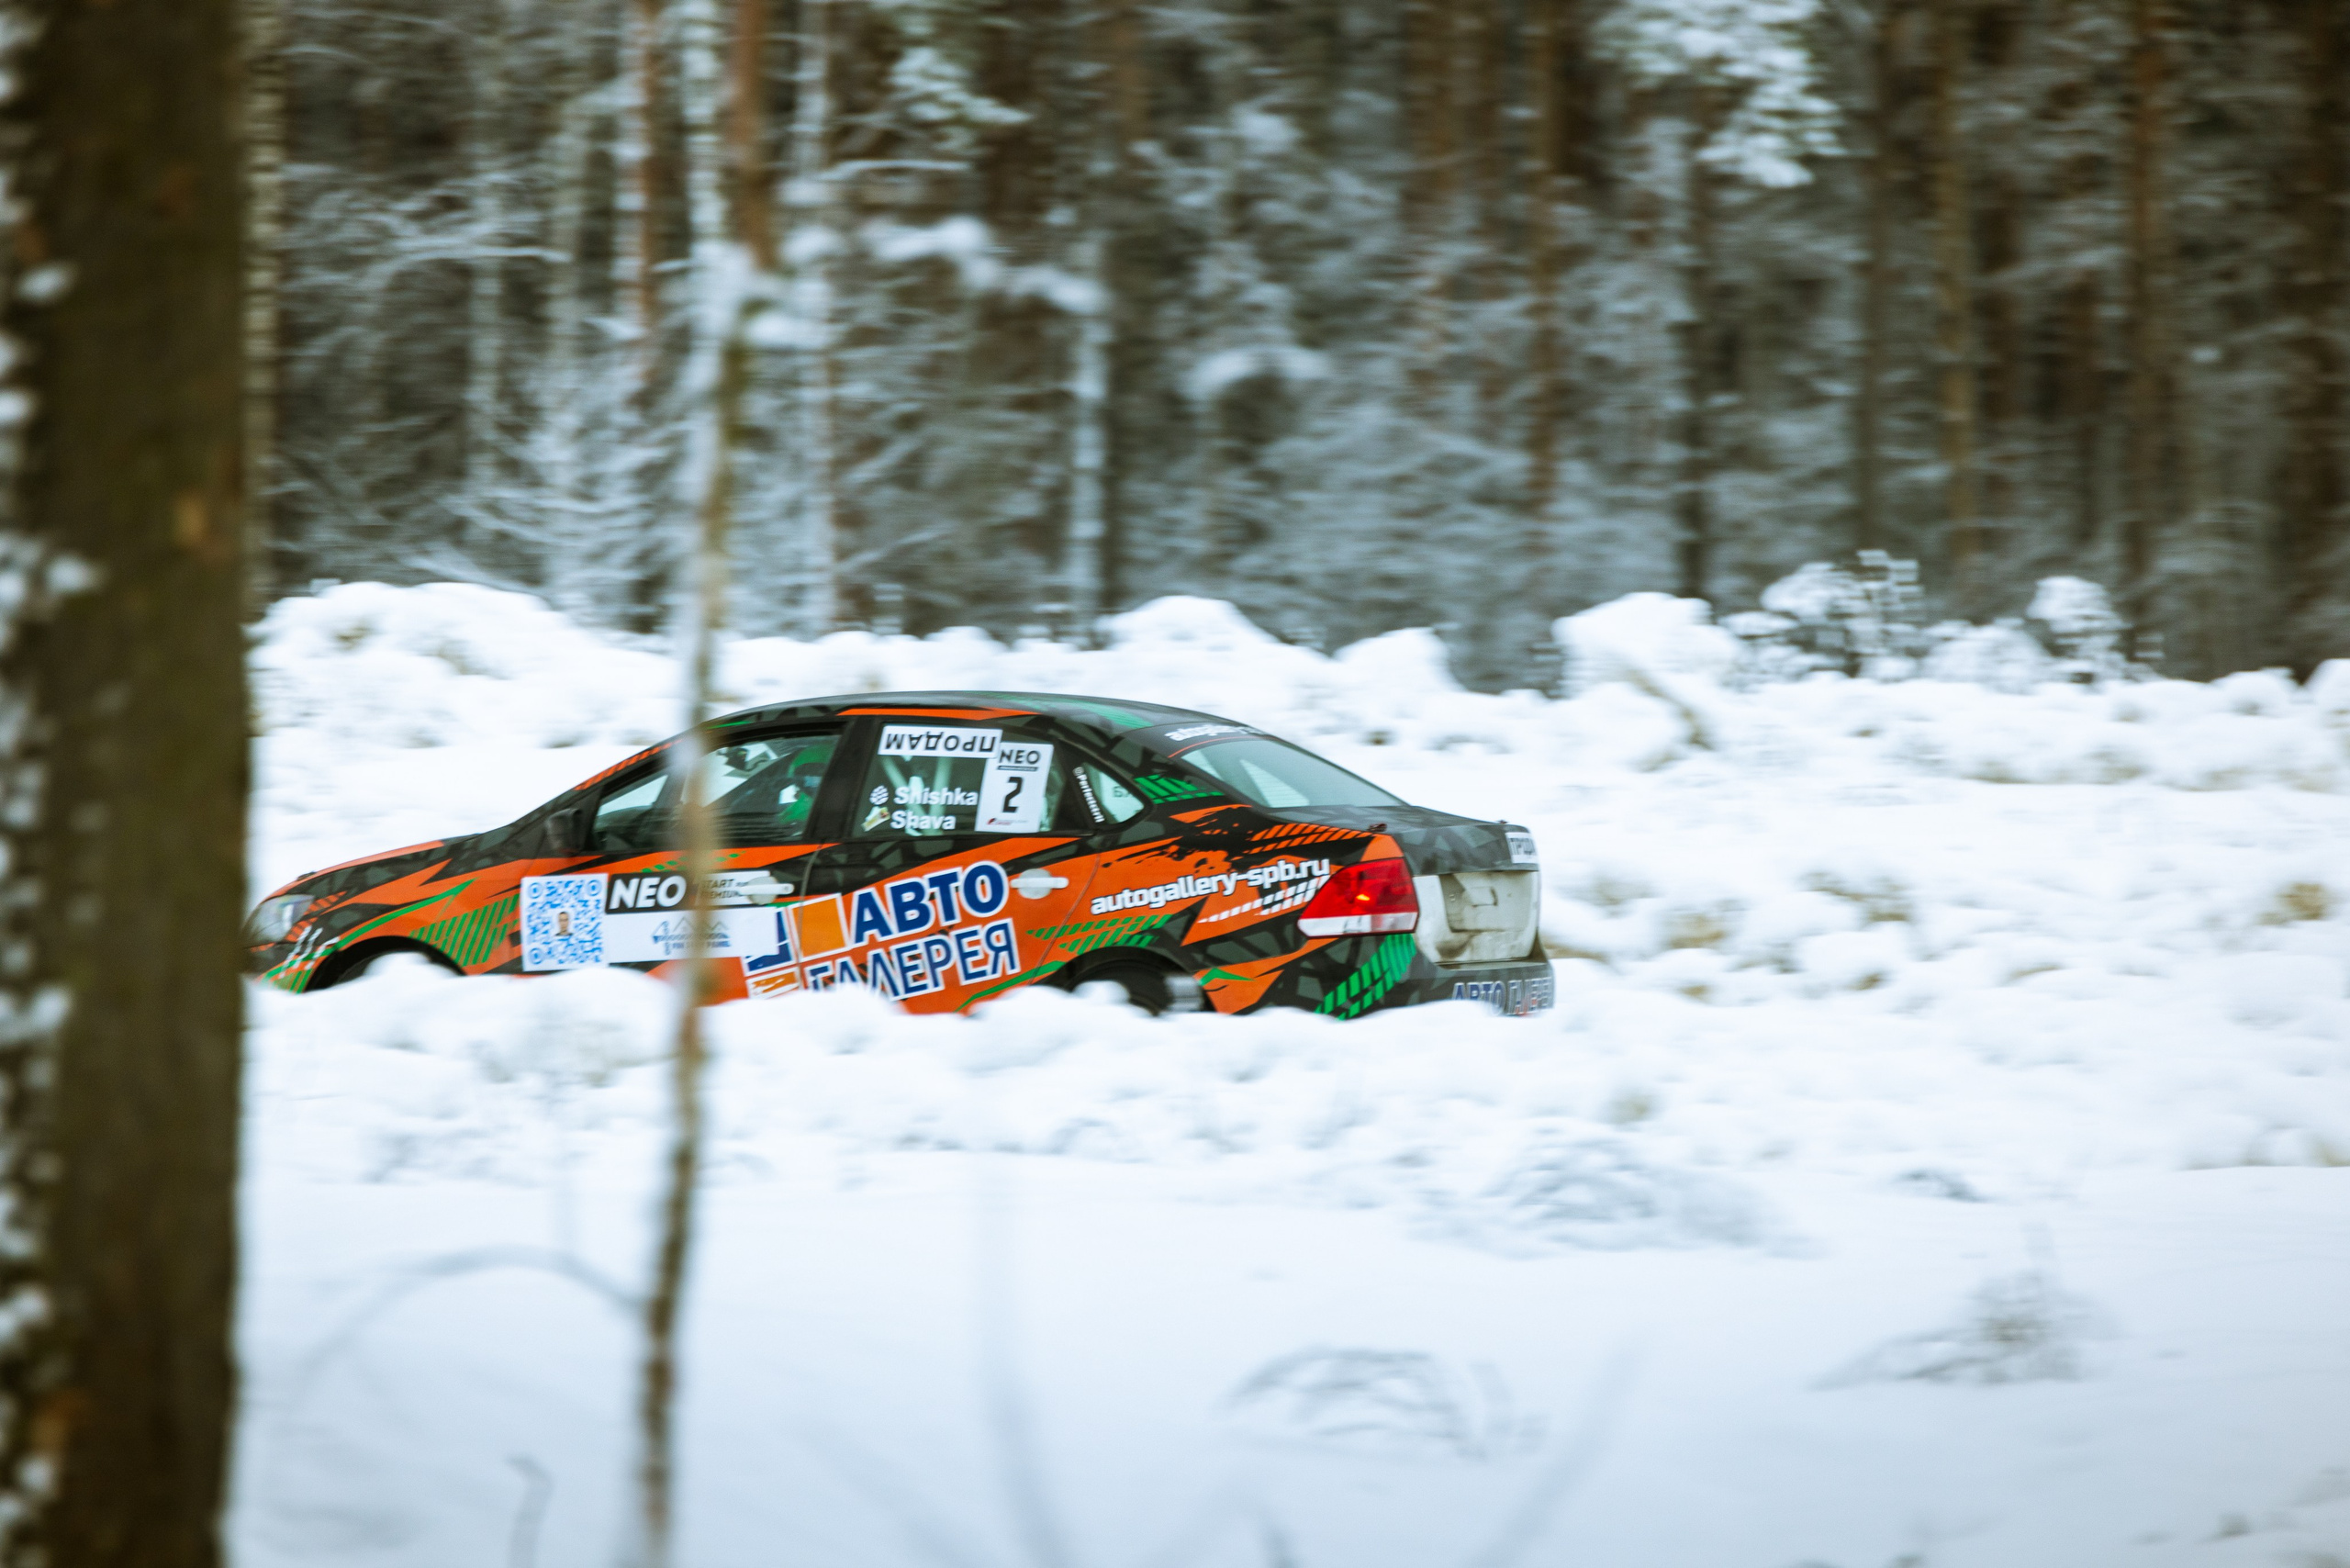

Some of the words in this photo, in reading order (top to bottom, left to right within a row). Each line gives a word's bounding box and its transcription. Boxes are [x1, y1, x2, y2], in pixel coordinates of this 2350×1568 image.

[885, 732, 997, 752] ПРОДАМ
[1000, 749, 1041, 766] NEO
[1002, 776, 1024, 813] 2
[610, 875, 687, 910] NEO
[852, 864, 1002, 944] АВТО
[1091, 857, 1331, 915] autogallery-spb.ru
